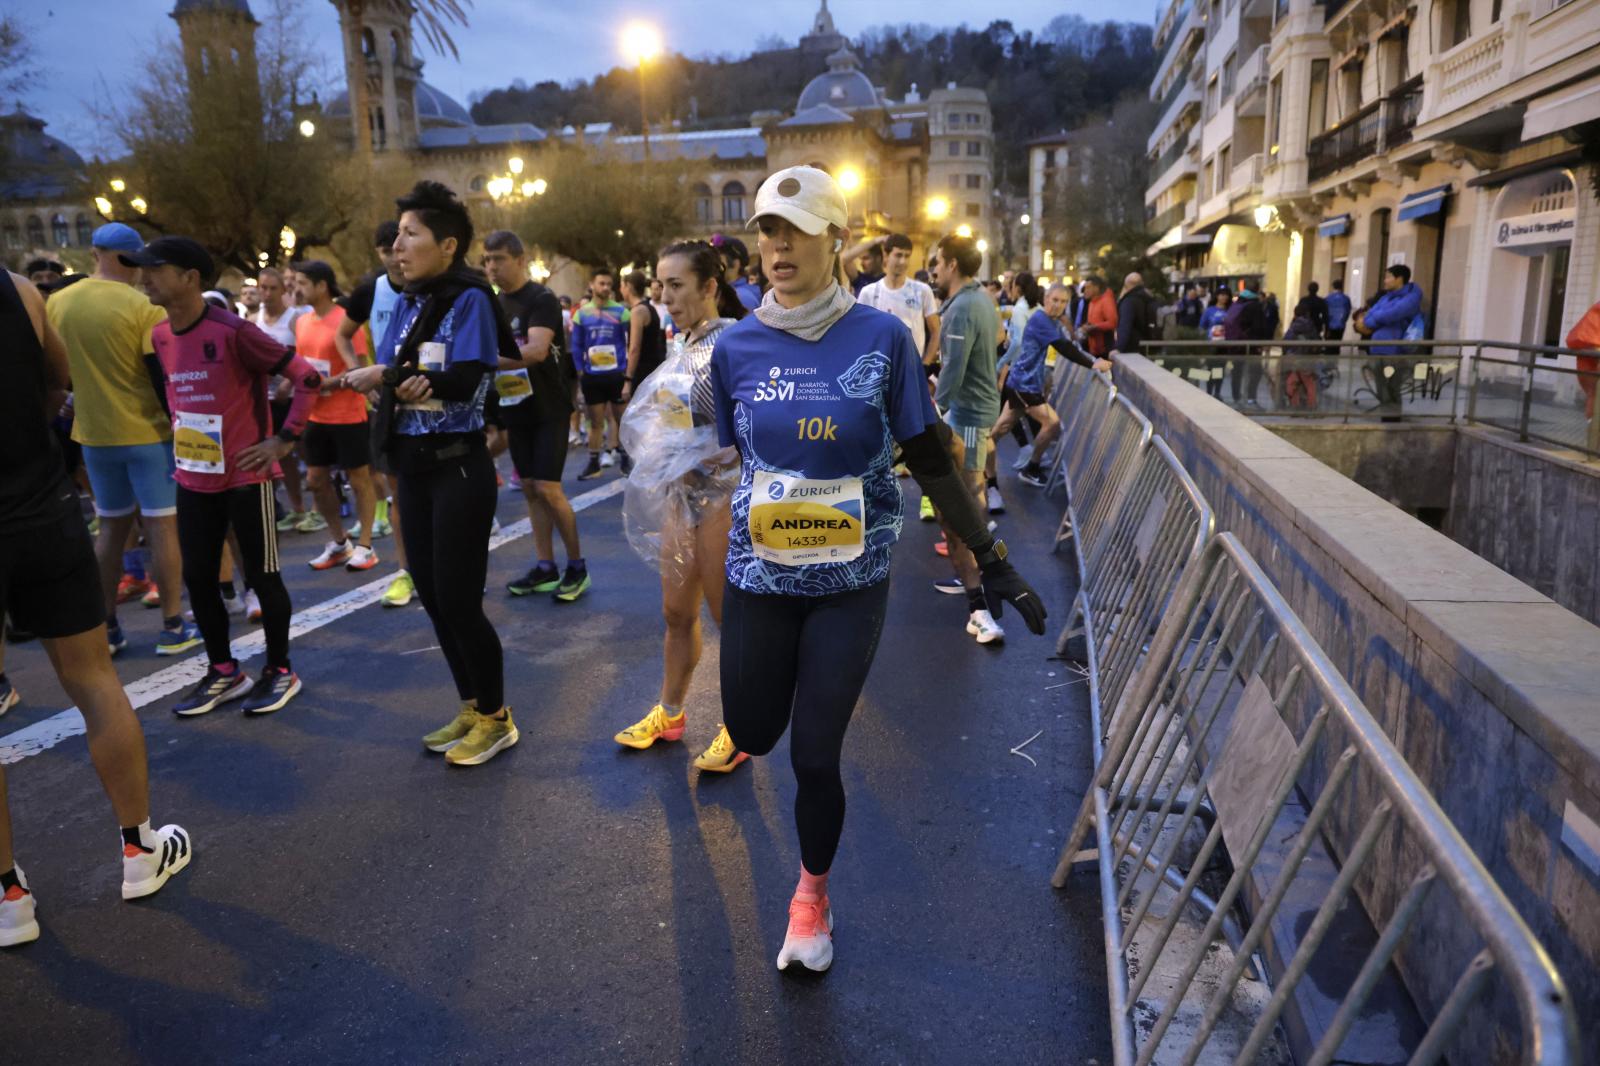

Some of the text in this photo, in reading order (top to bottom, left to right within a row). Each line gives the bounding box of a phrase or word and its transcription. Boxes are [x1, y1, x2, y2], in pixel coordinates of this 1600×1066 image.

[784, 367, 817, 376] ZURICH
[808, 393, 841, 401] SEBASTIÁN
[797, 416, 838, 441] 10k
[790, 485, 842, 498] ZURICH
[771, 518, 852, 530] ANDREA
[786, 535, 827, 548] 14339
